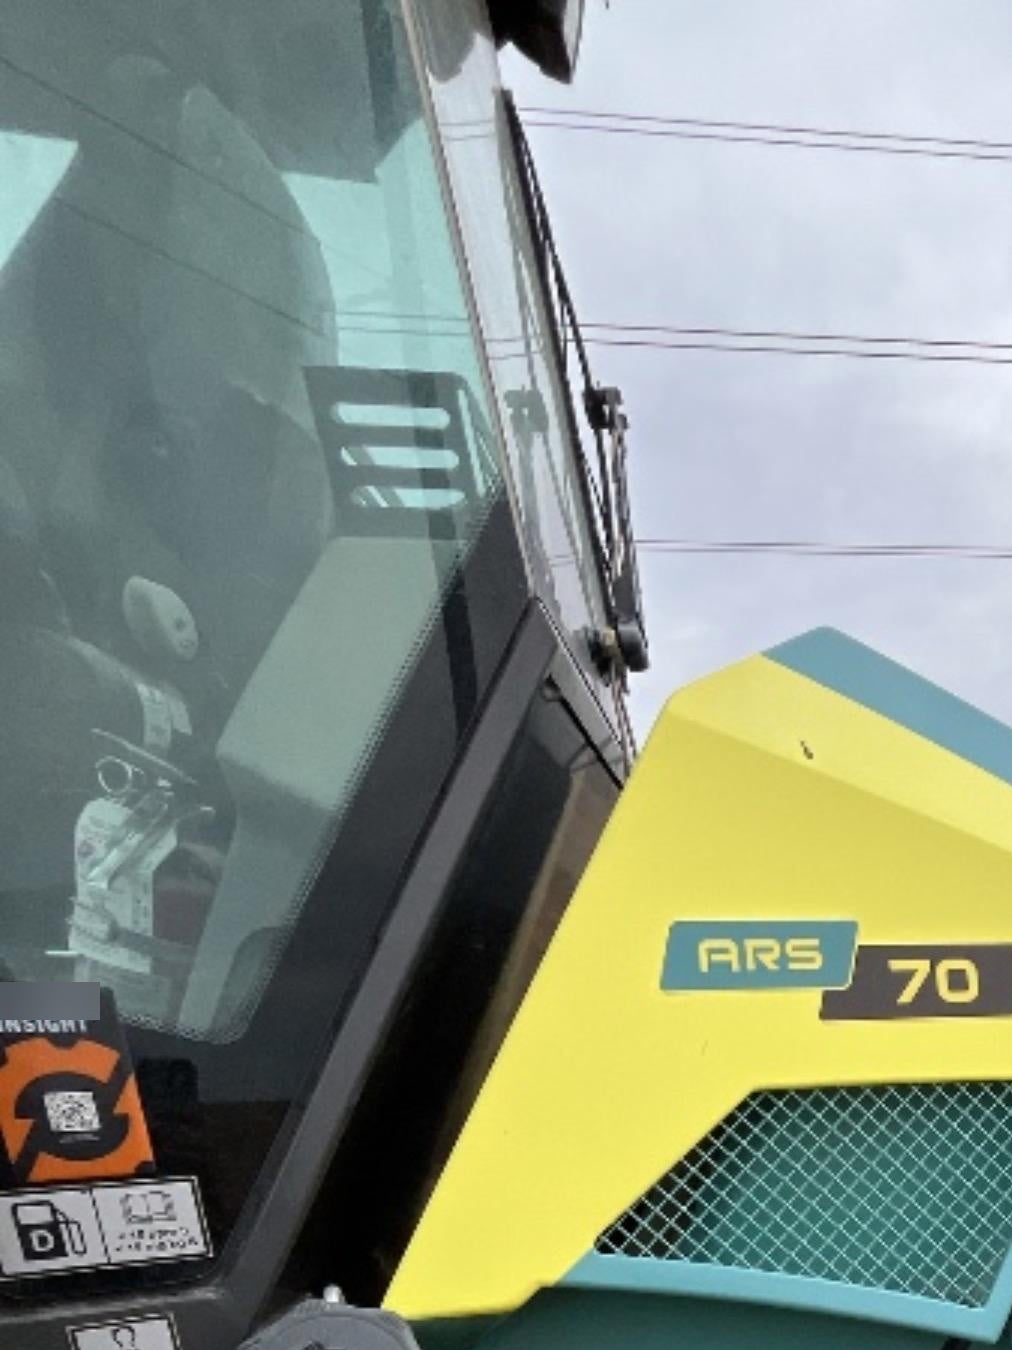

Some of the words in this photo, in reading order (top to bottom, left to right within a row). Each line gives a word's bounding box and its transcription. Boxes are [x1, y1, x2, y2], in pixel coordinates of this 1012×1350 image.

[698, 938, 823, 972] ARS
[887, 958, 980, 1004] 70
[30, 1230, 54, 1251] D
